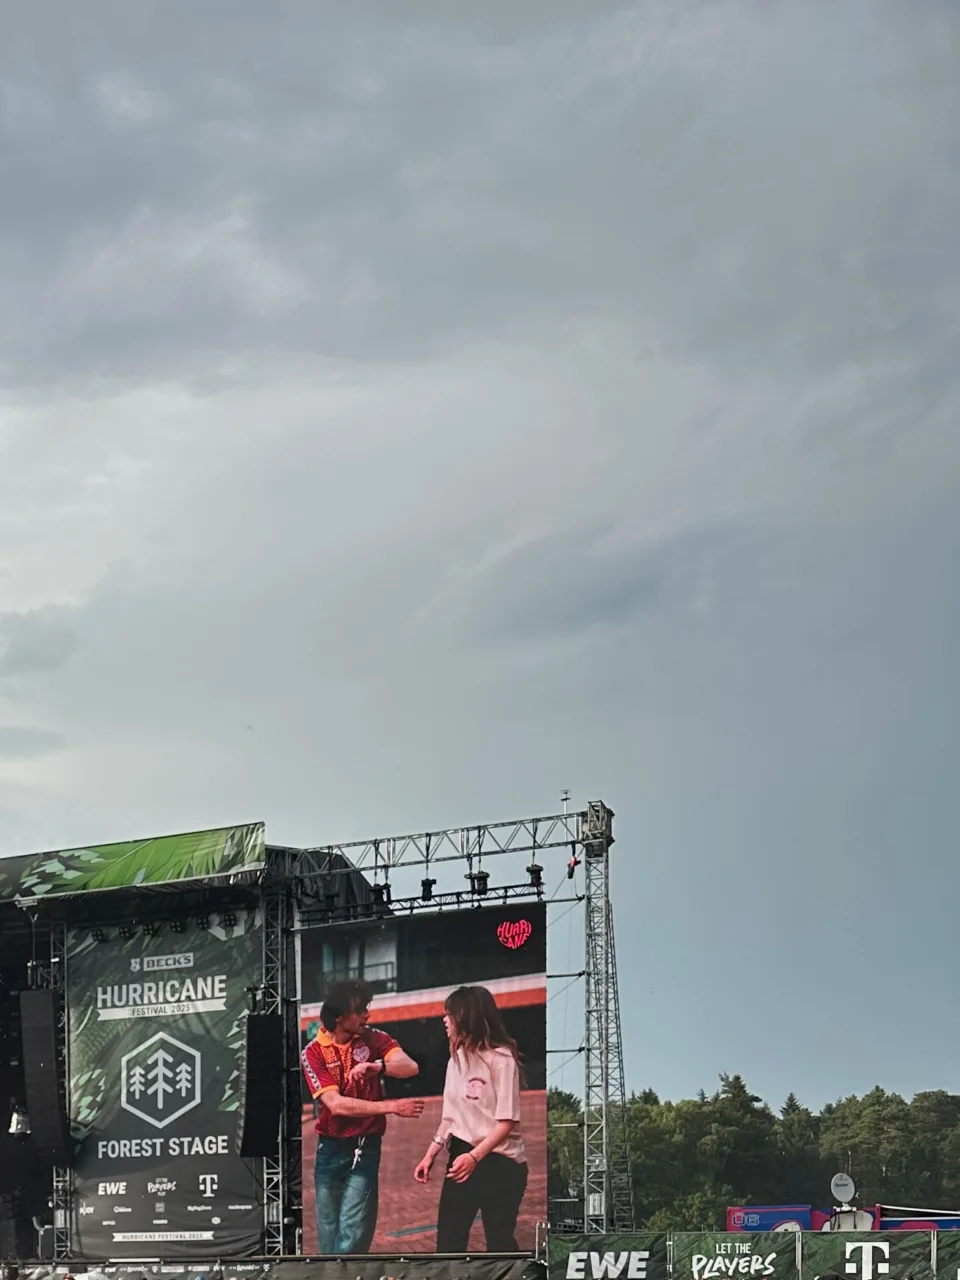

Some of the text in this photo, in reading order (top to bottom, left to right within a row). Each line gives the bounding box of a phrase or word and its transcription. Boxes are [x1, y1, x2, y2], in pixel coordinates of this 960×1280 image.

[146, 955, 192, 969] BECK'S
[97, 975, 228, 1009] HURRICANE
[131, 1004, 191, 1017] FESTIVAL 2025
[97, 1135, 229, 1159] FOREST STAGE
[98, 1182, 127, 1195] EWE
[716, 1242, 751, 1254] LET THE
[566, 1250, 650, 1279] EWE
[691, 1252, 777, 1280] PLAYERS
